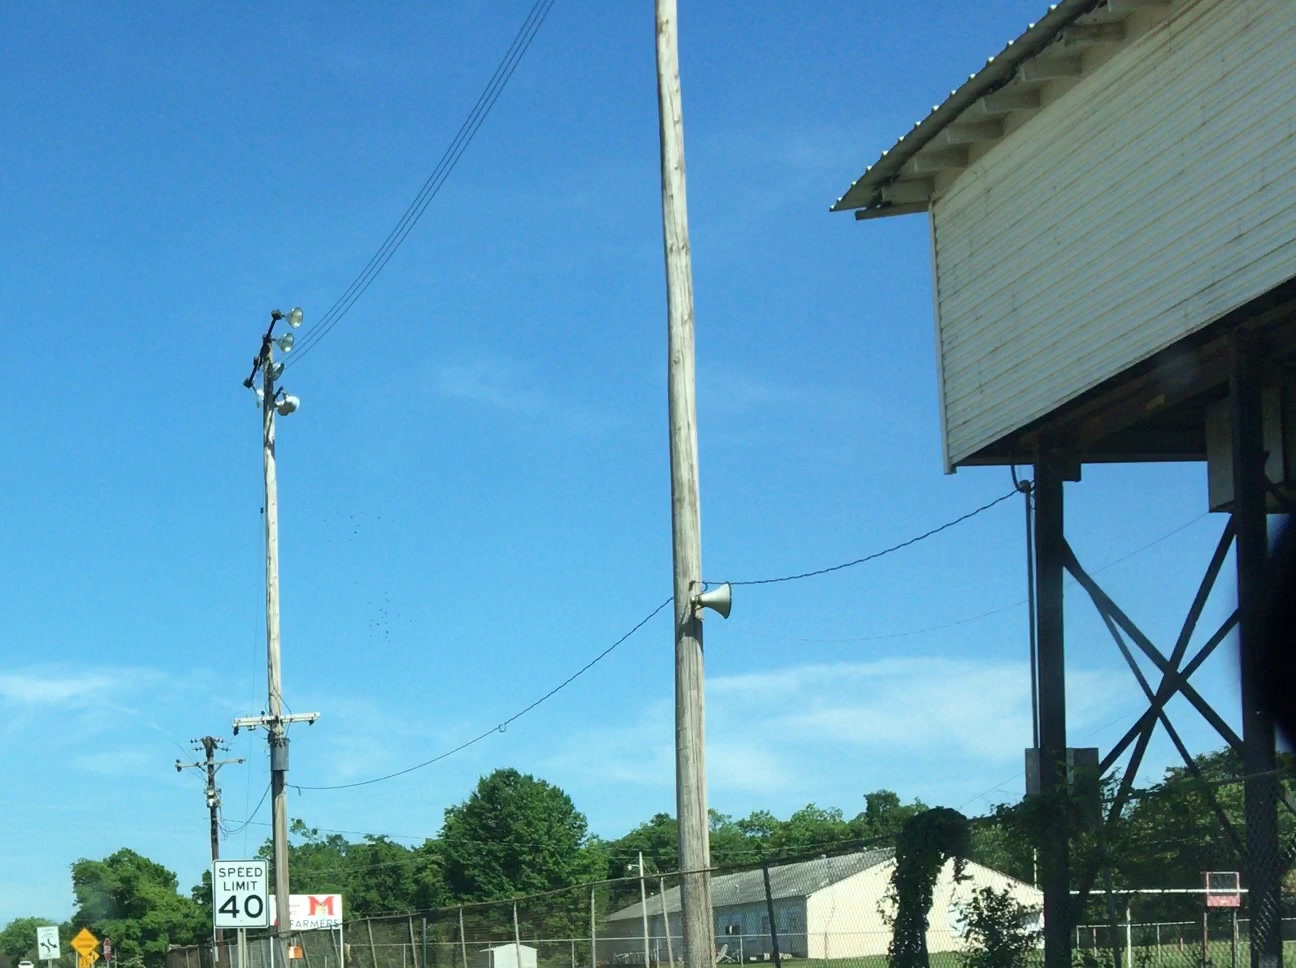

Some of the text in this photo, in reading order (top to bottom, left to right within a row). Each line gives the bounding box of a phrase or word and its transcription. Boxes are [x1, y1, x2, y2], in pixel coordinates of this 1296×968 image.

[218, 867, 263, 878] SPEED
[223, 881, 258, 891] LIMIT
[218, 894, 264, 918] 40
[290, 919, 339, 928] FARMERS
